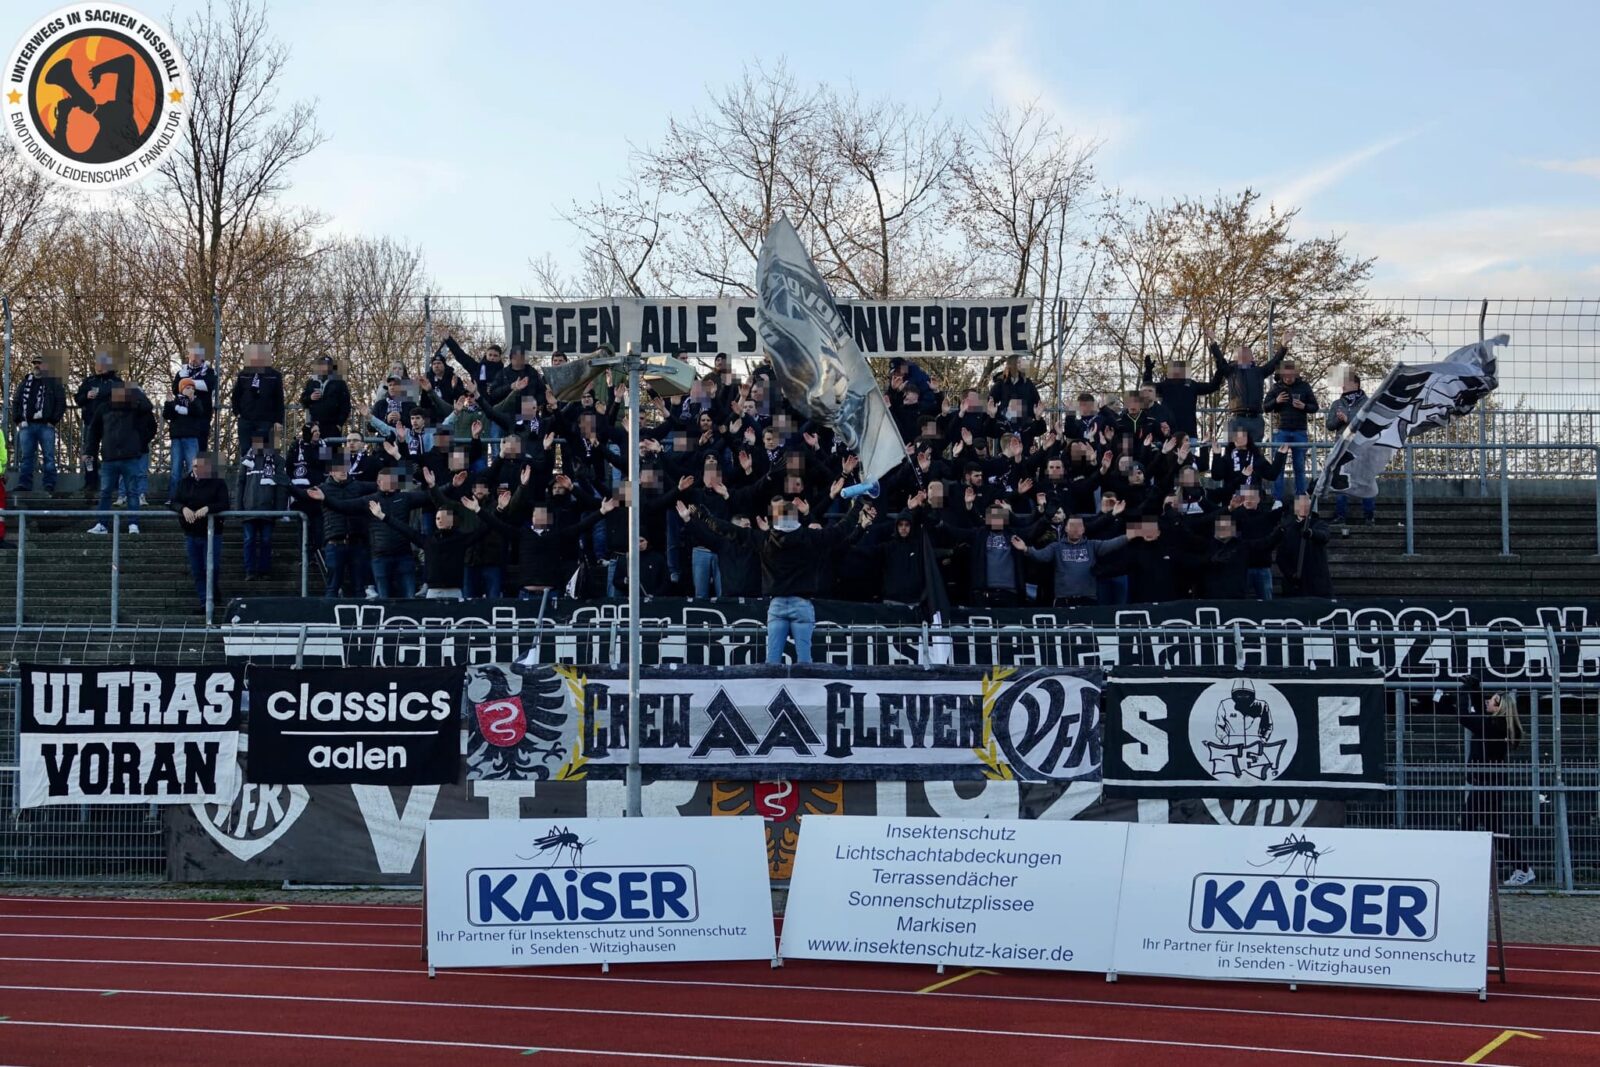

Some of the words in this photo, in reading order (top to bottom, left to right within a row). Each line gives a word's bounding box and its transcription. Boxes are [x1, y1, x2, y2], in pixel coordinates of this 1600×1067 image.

[510, 304, 620, 353] GEGEN
[641, 305, 718, 353] ALLE
[31, 671, 235, 726] ULTRAS
[266, 682, 451, 722] classics
[823, 682, 987, 758] ELEVEN
[308, 741, 408, 771] aalen
[41, 741, 219, 797] VORAN
[886, 823, 1016, 841] Insektenschutz
[835, 844, 1062, 868] Lichtschachtabdeckungen
[872, 868, 1018, 888] Terrassendächer
[848, 891, 1035, 914] Sonnenschutzplissee
[436, 930, 455, 942] Ihr
[458, 929, 504, 942] Partner
[508, 929, 527, 941] für
[530, 927, 626, 940] Insektenschutz
[629, 926, 655, 939] und
[658, 925, 747, 938] Sonnenschutz
[896, 916, 977, 934] Markisen
[511, 943, 524, 955] in
[531, 942, 579, 955] Senden
[590, 941, 676, 956] Witzighausen
[807, 937, 1074, 962] www.insektenschutz-kaiser.de
[1142, 938, 1160, 951] Ihr
[1164, 938, 1212, 953] Partner
[1215, 940, 1235, 953] für
[1237, 941, 1340, 957] Insektenschutz
[1343, 945, 1371, 959] und
[1375, 946, 1477, 964] Sonnenschutz
[1218, 957, 1231, 969] in
[1234, 957, 1285, 971] Senden
[1297, 959, 1392, 976] Witzighausen
